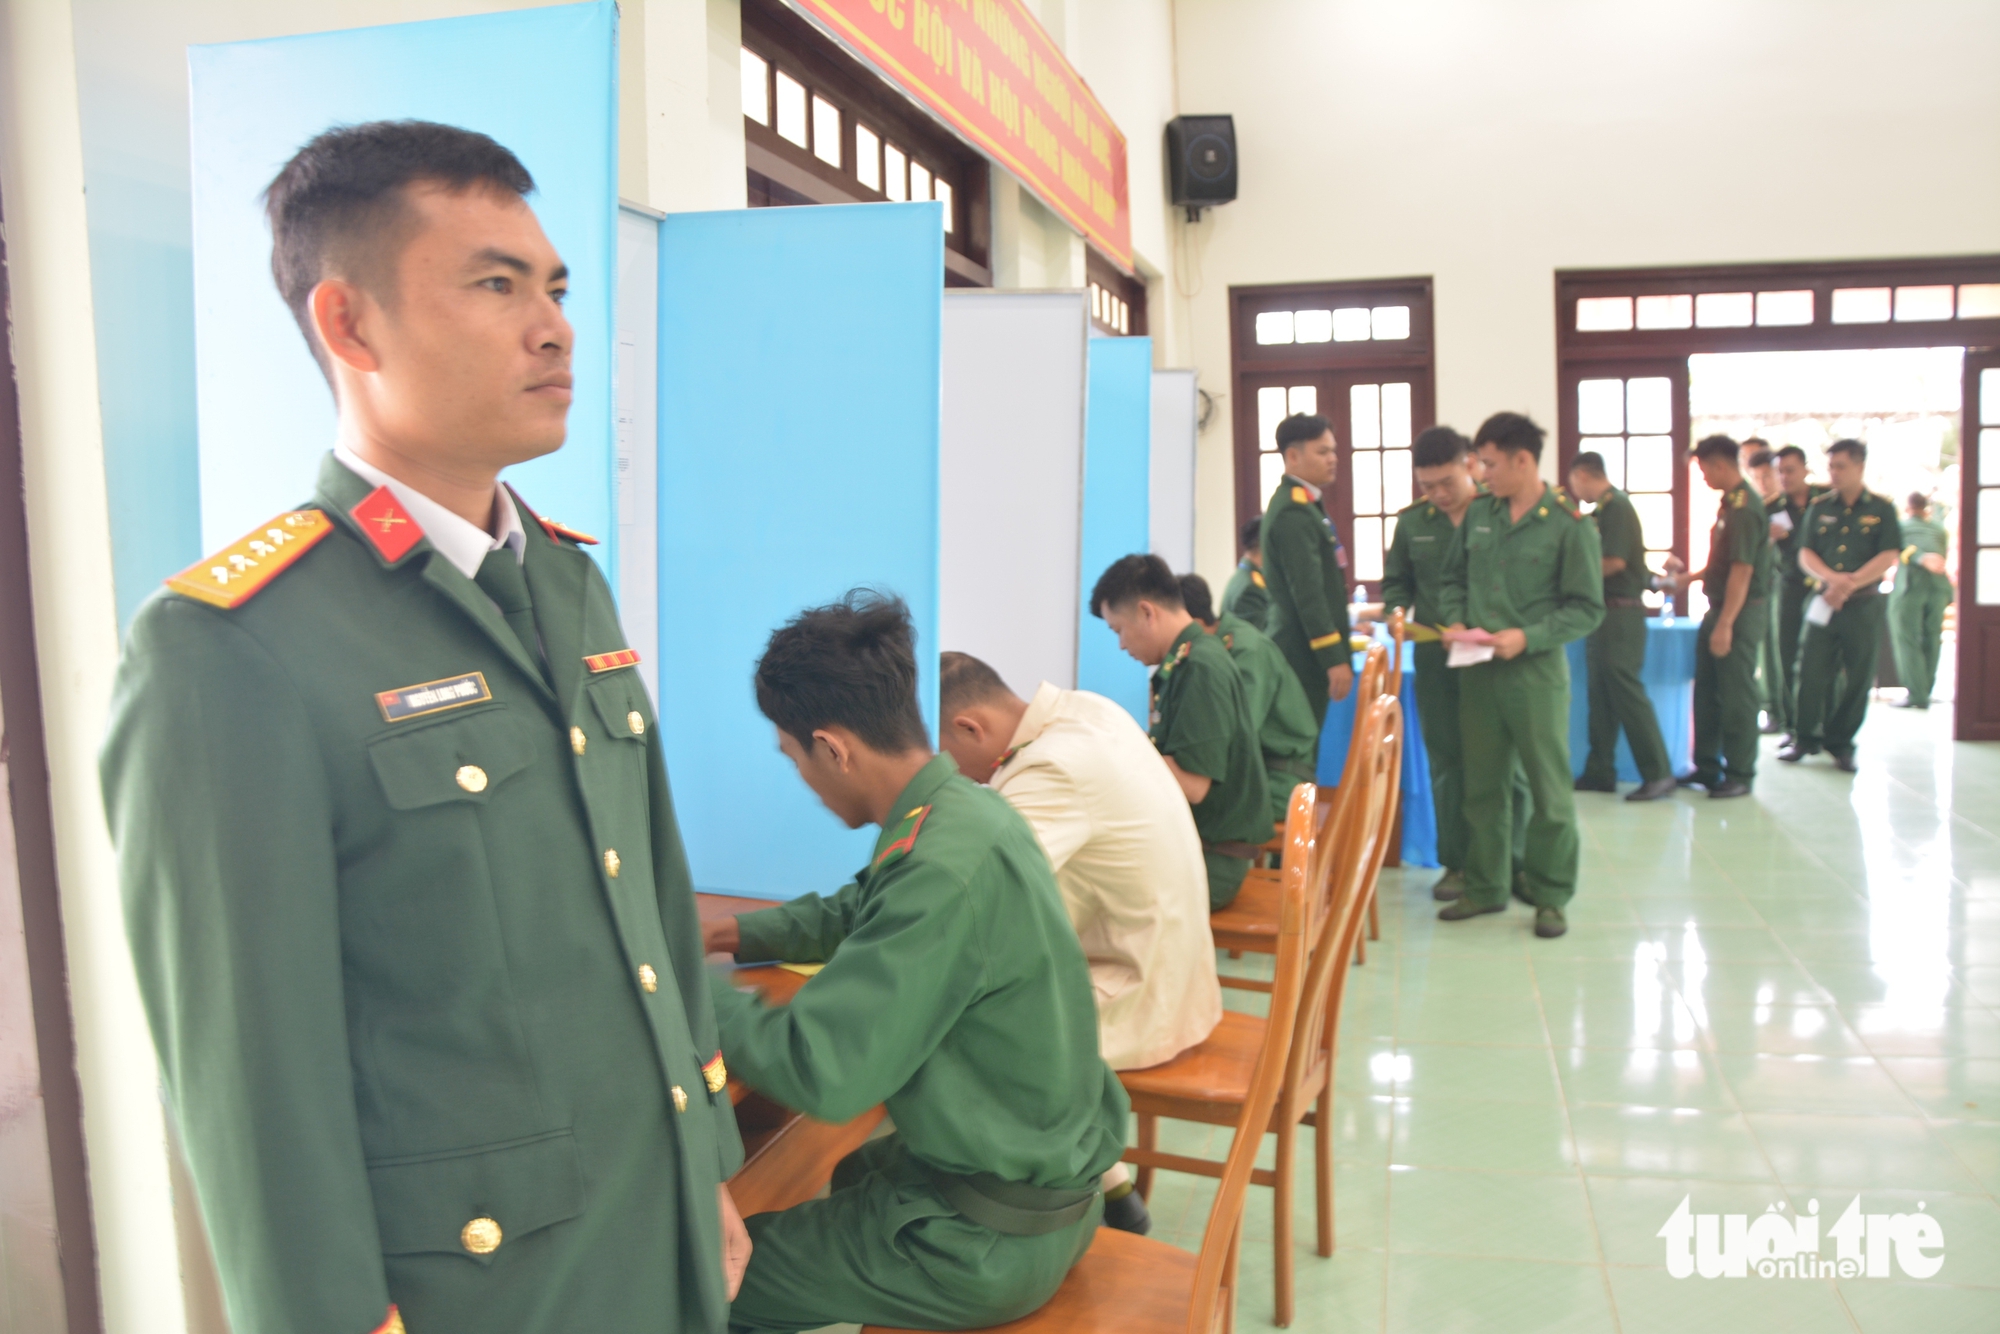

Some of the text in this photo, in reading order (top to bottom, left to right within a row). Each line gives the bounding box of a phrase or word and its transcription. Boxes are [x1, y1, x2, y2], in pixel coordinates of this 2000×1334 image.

[913, 0, 952, 77] HỘI
[957, 37, 985, 107] VÀ
[988, 69, 1020, 137] HỘI
